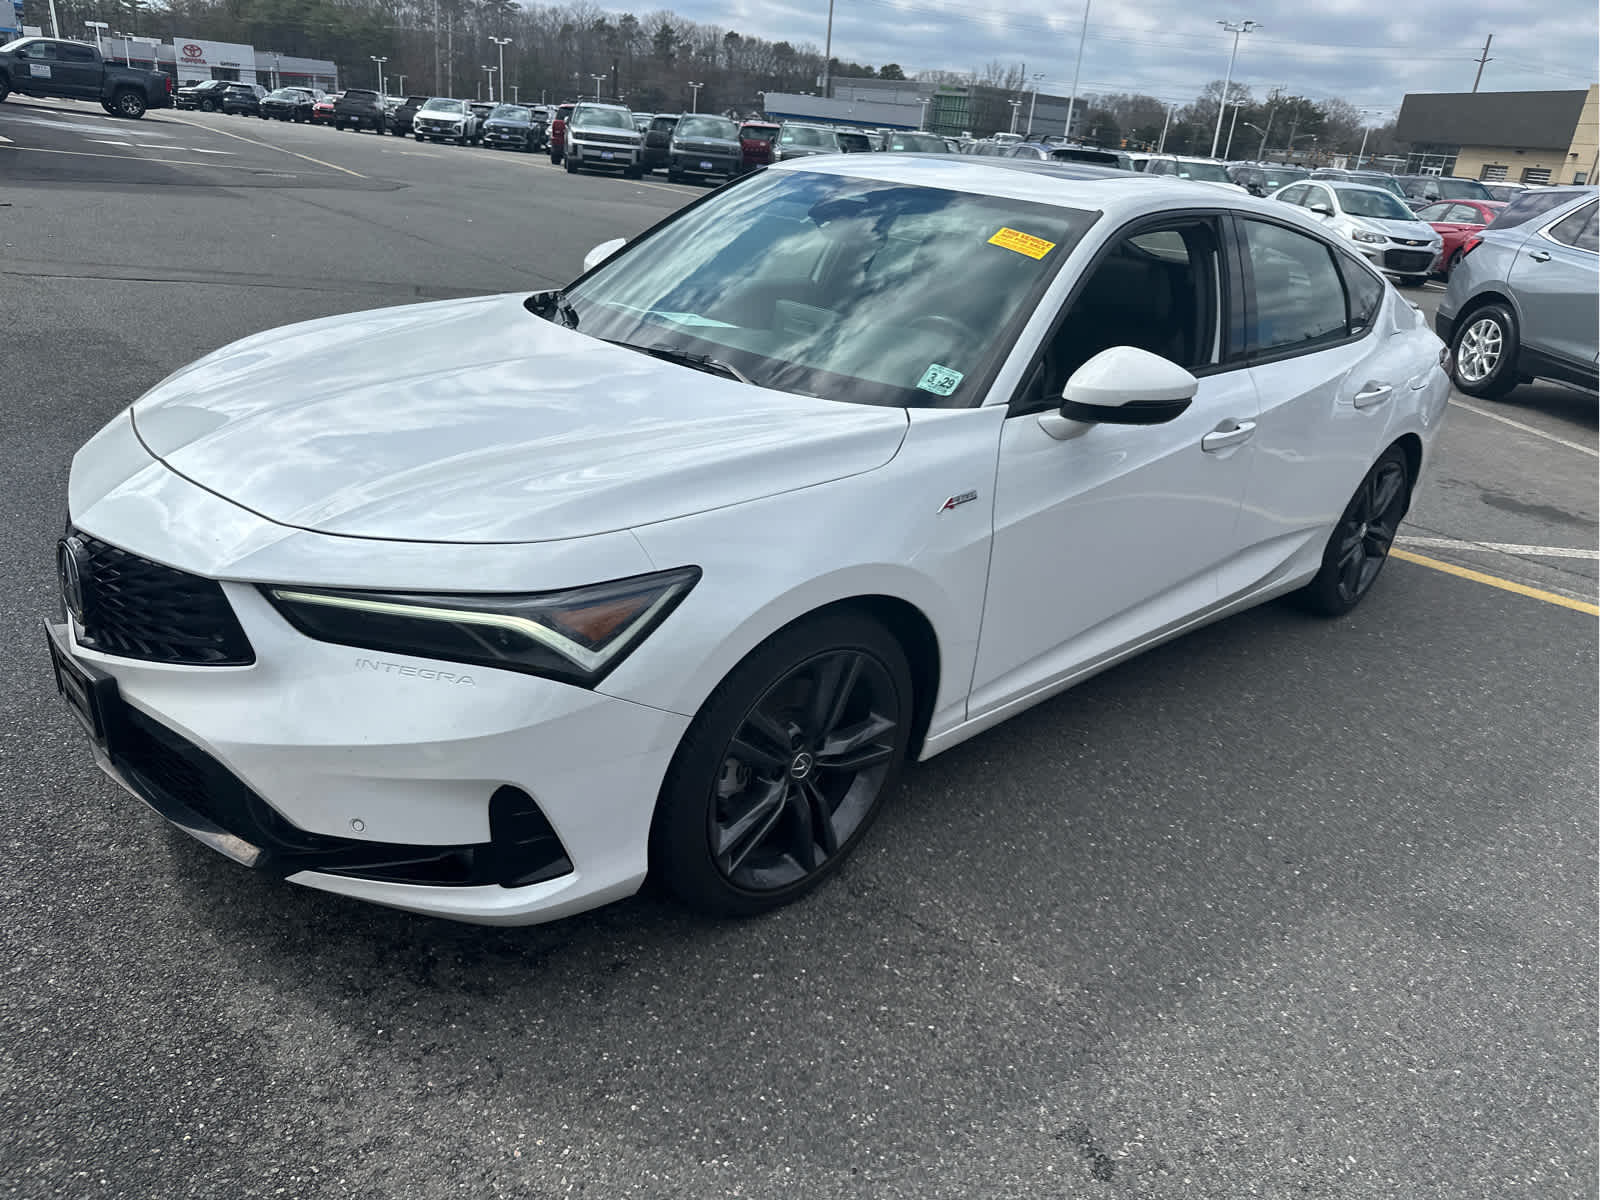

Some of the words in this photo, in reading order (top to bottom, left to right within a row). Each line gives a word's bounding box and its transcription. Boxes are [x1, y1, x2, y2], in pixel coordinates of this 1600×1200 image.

[180, 57, 207, 65] TOYOTA
[1020, 234, 1053, 248] VEHICLE
[355, 658, 476, 686] INTEGRA
